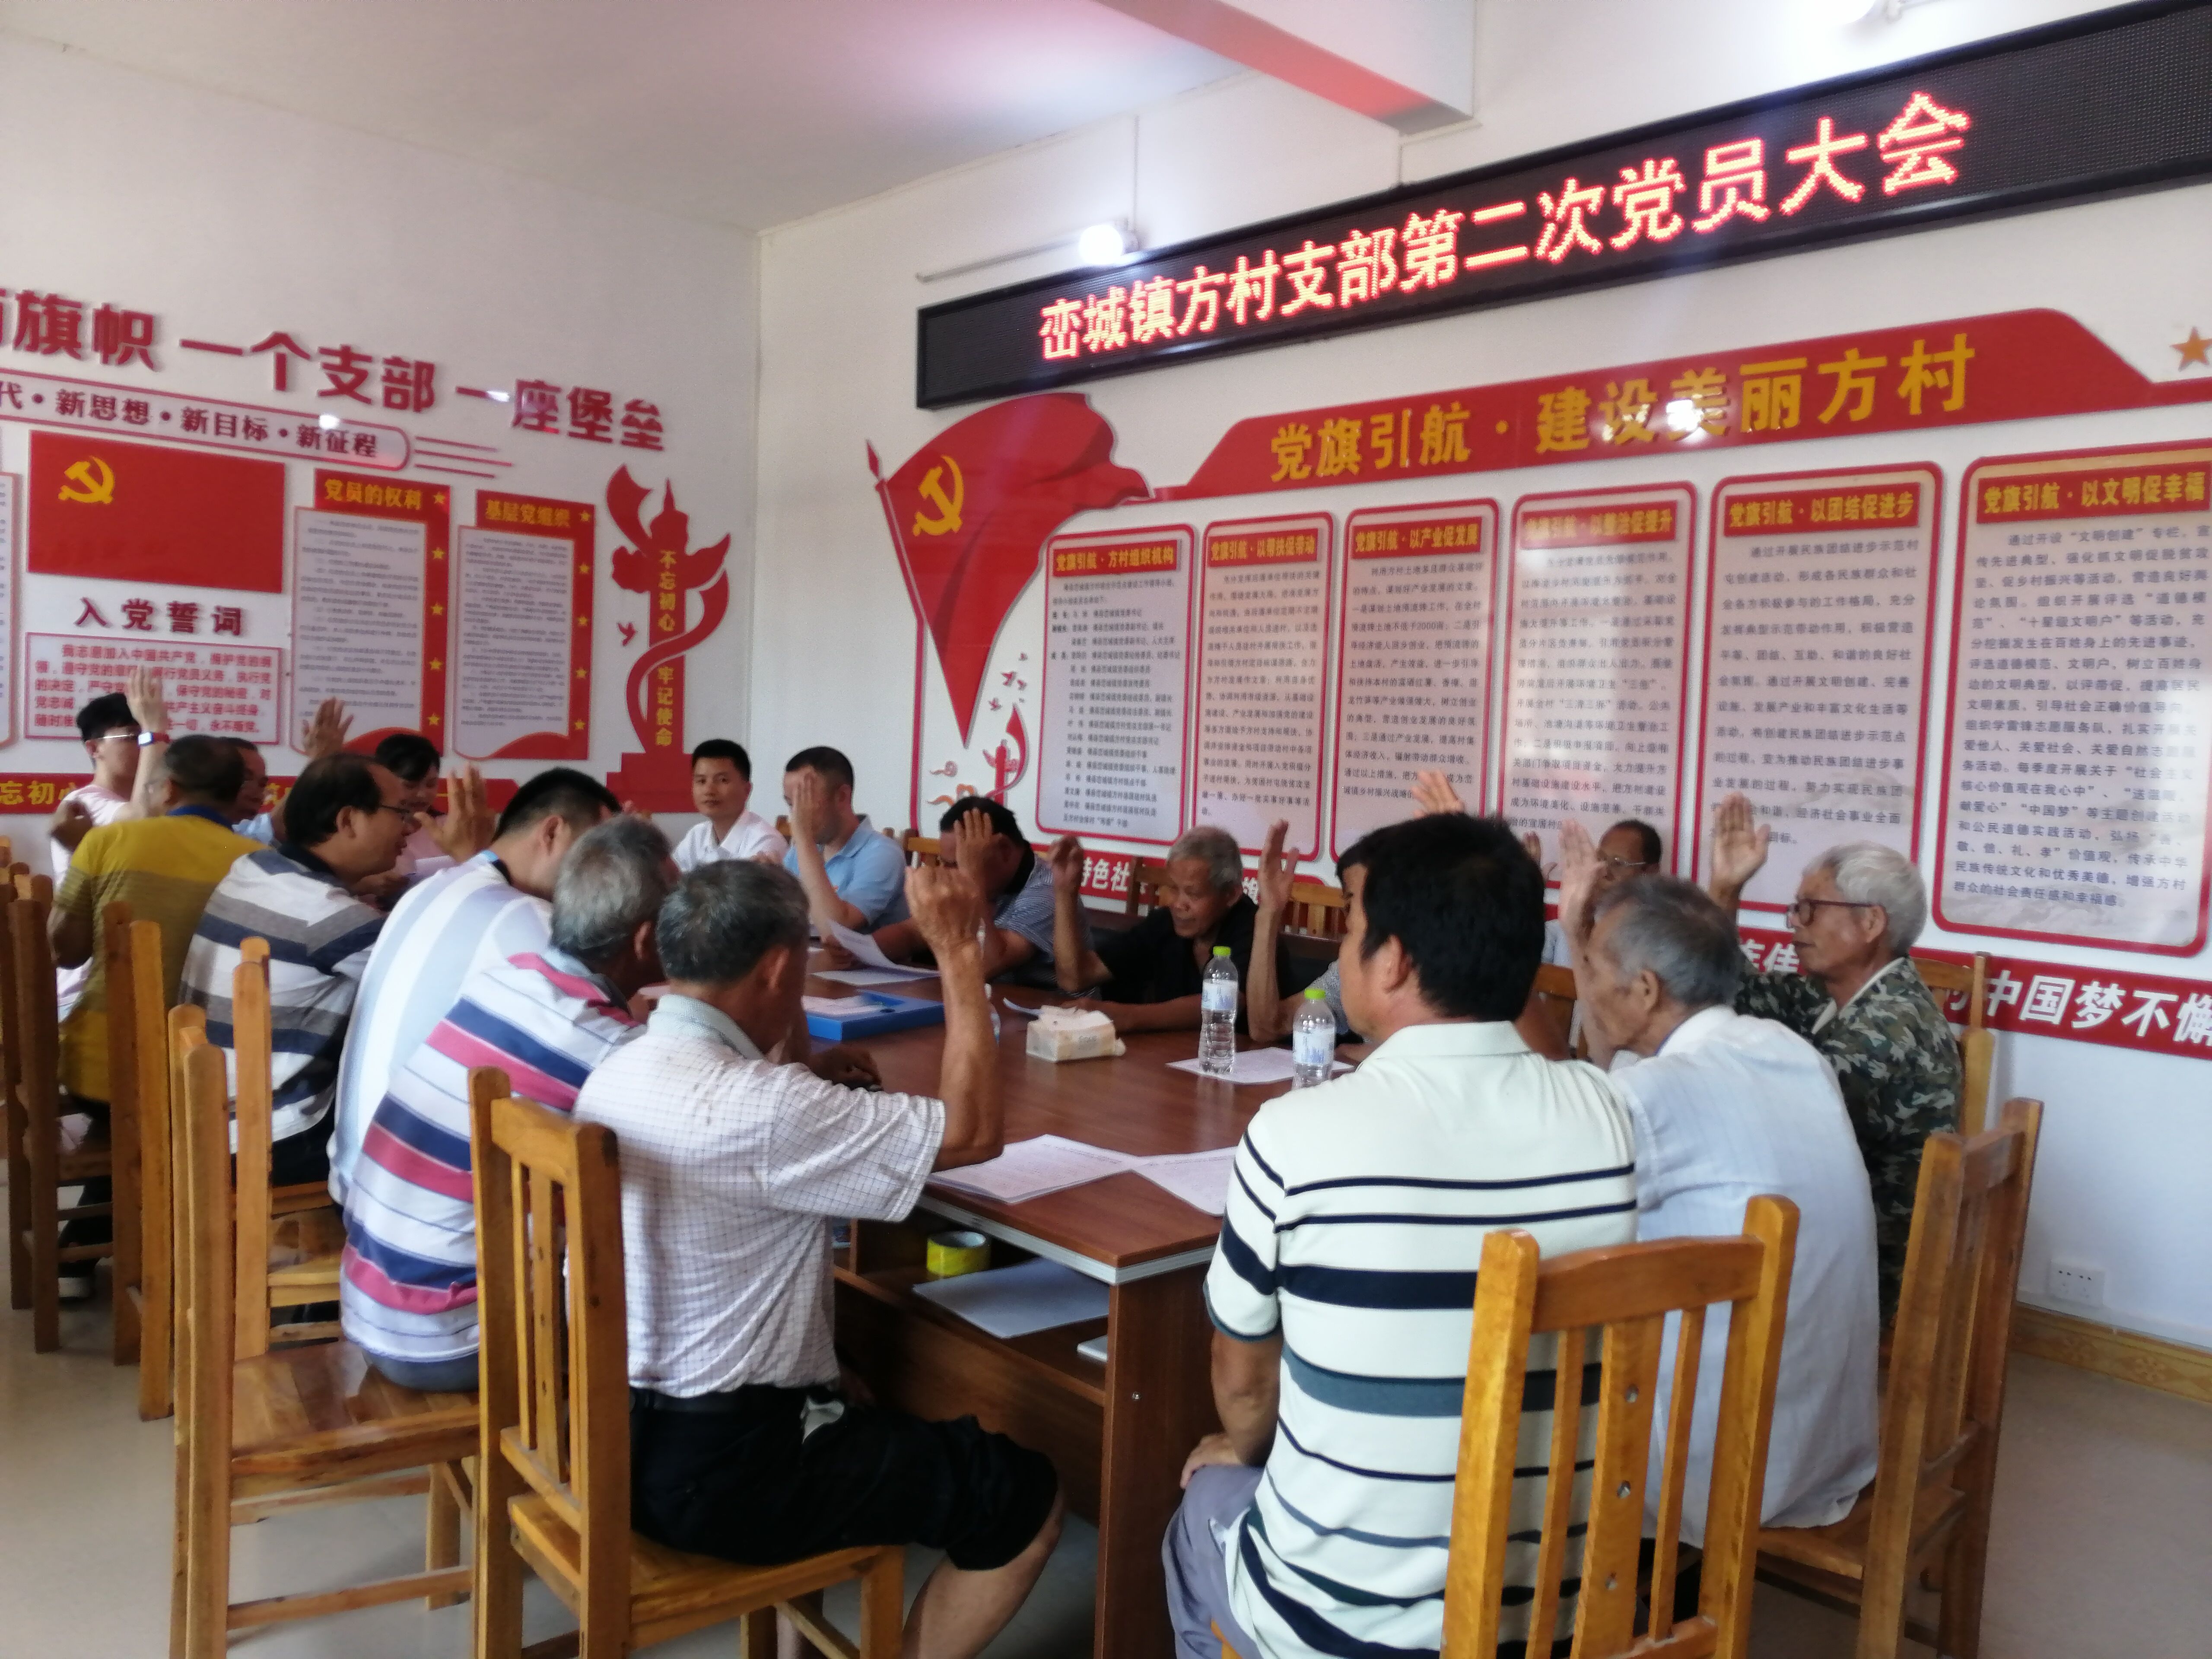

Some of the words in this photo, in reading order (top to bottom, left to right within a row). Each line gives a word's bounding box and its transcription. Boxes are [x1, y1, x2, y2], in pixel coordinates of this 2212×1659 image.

[1039, 92, 1970, 360] 峦城镇方村支部第二次党员大会
[0, 288, 154, 372] 旗帜
[179, 331, 436, 413] 一个支部
[455, 378, 665, 452] 一座堡垒
[324, 478, 422, 510] 党员的权利
[74, 597, 242, 636] 入党誓词
[658, 550, 677, 632] 不忘初心
[655, 667, 674, 747] 牢记使命
[1944, 969, 2212, 1046] 中国梦不懈
